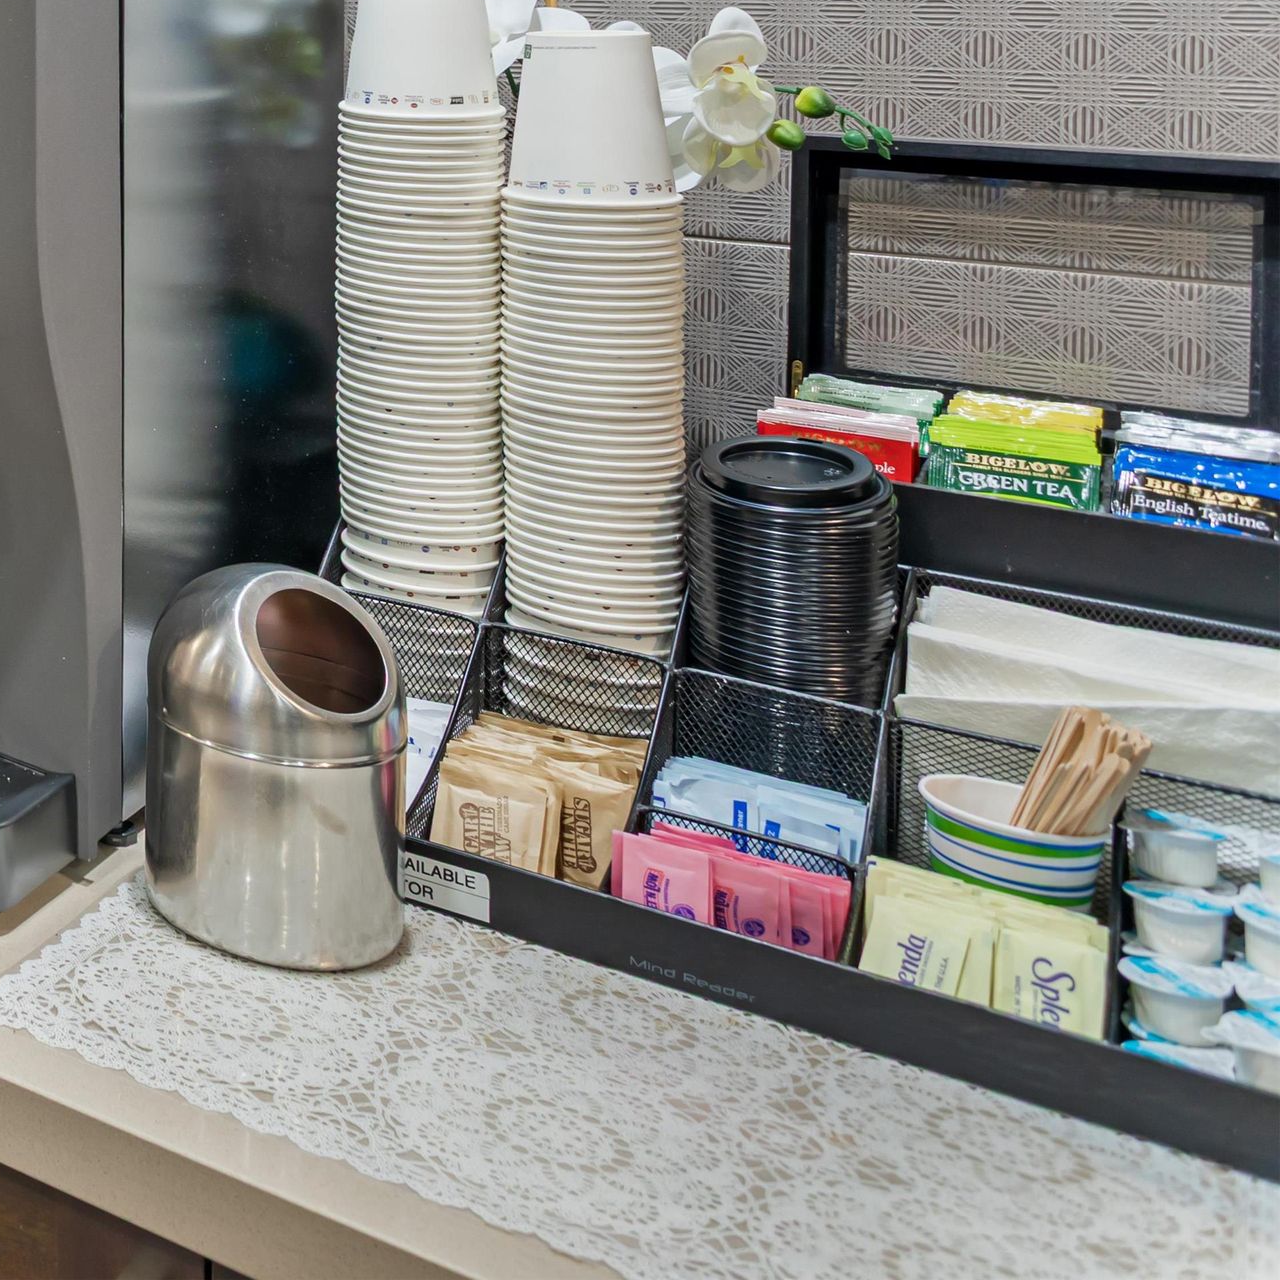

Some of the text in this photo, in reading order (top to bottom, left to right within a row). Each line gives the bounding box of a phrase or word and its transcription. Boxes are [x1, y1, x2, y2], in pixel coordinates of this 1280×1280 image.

[964, 452, 1070, 476] BIGELOW
[958, 470, 1076, 500] GREEN TEA
[1144, 476, 1261, 508] BIGELOW
[1133, 494, 1194, 517] English
[463, 816, 480, 852] GAR
[572, 796, 592, 858] SUGAR
[494, 834, 512, 864] AW
[562, 830, 578, 870] THE
[404, 857, 476, 890] AILABLE
[404, 878, 434, 900] OR
[644, 871, 660, 892] LOW
[896, 933, 927, 986] enda
[629, 955, 756, 1003] Mind Reader
